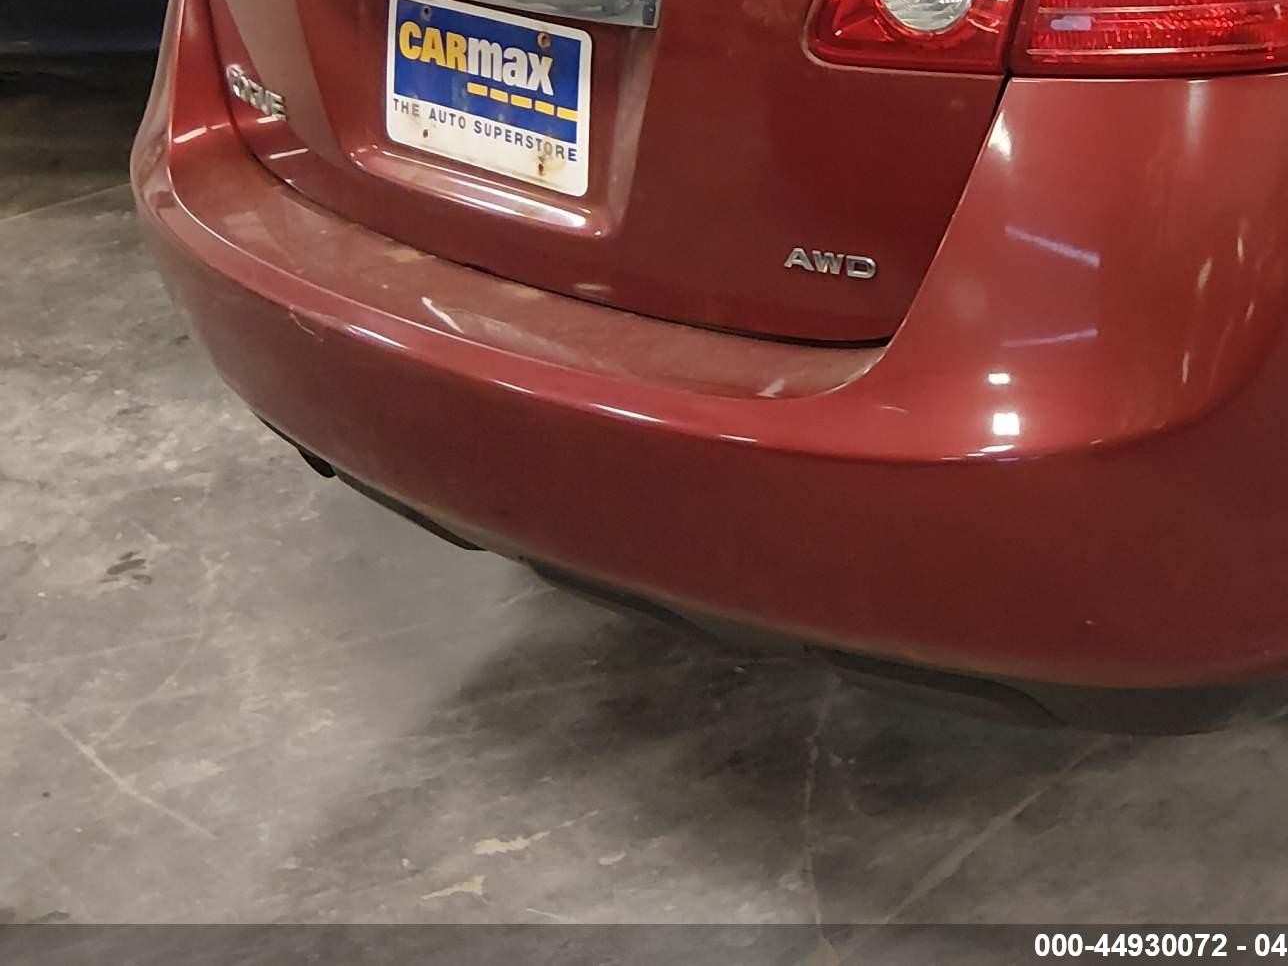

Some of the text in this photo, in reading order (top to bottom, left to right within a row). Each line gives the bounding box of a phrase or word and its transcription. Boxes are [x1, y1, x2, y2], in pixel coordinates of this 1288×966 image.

[399, 21, 554, 96] CARmax
[393, 98, 578, 162] THE AUTO SUPERSTORE
[783, 247, 877, 279] AWD
